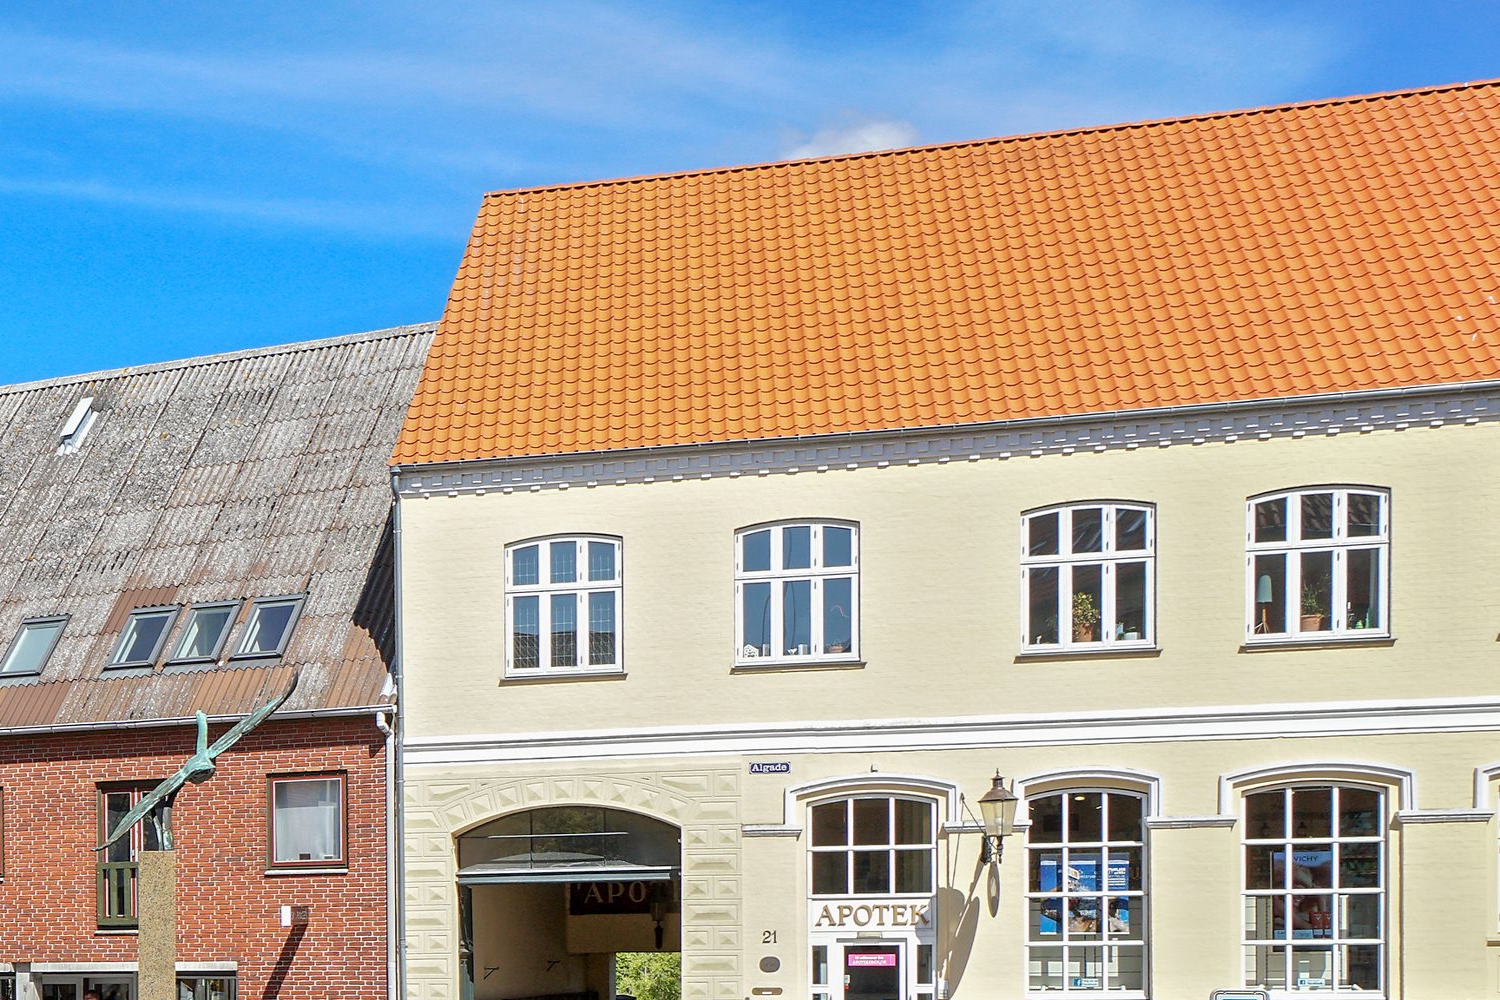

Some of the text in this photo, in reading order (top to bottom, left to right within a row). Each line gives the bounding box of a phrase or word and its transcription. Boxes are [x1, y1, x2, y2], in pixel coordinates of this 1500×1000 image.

[752, 763, 787, 774] Algade
[815, 904, 930, 927] APOTEK
[762, 930, 778, 944] 21
